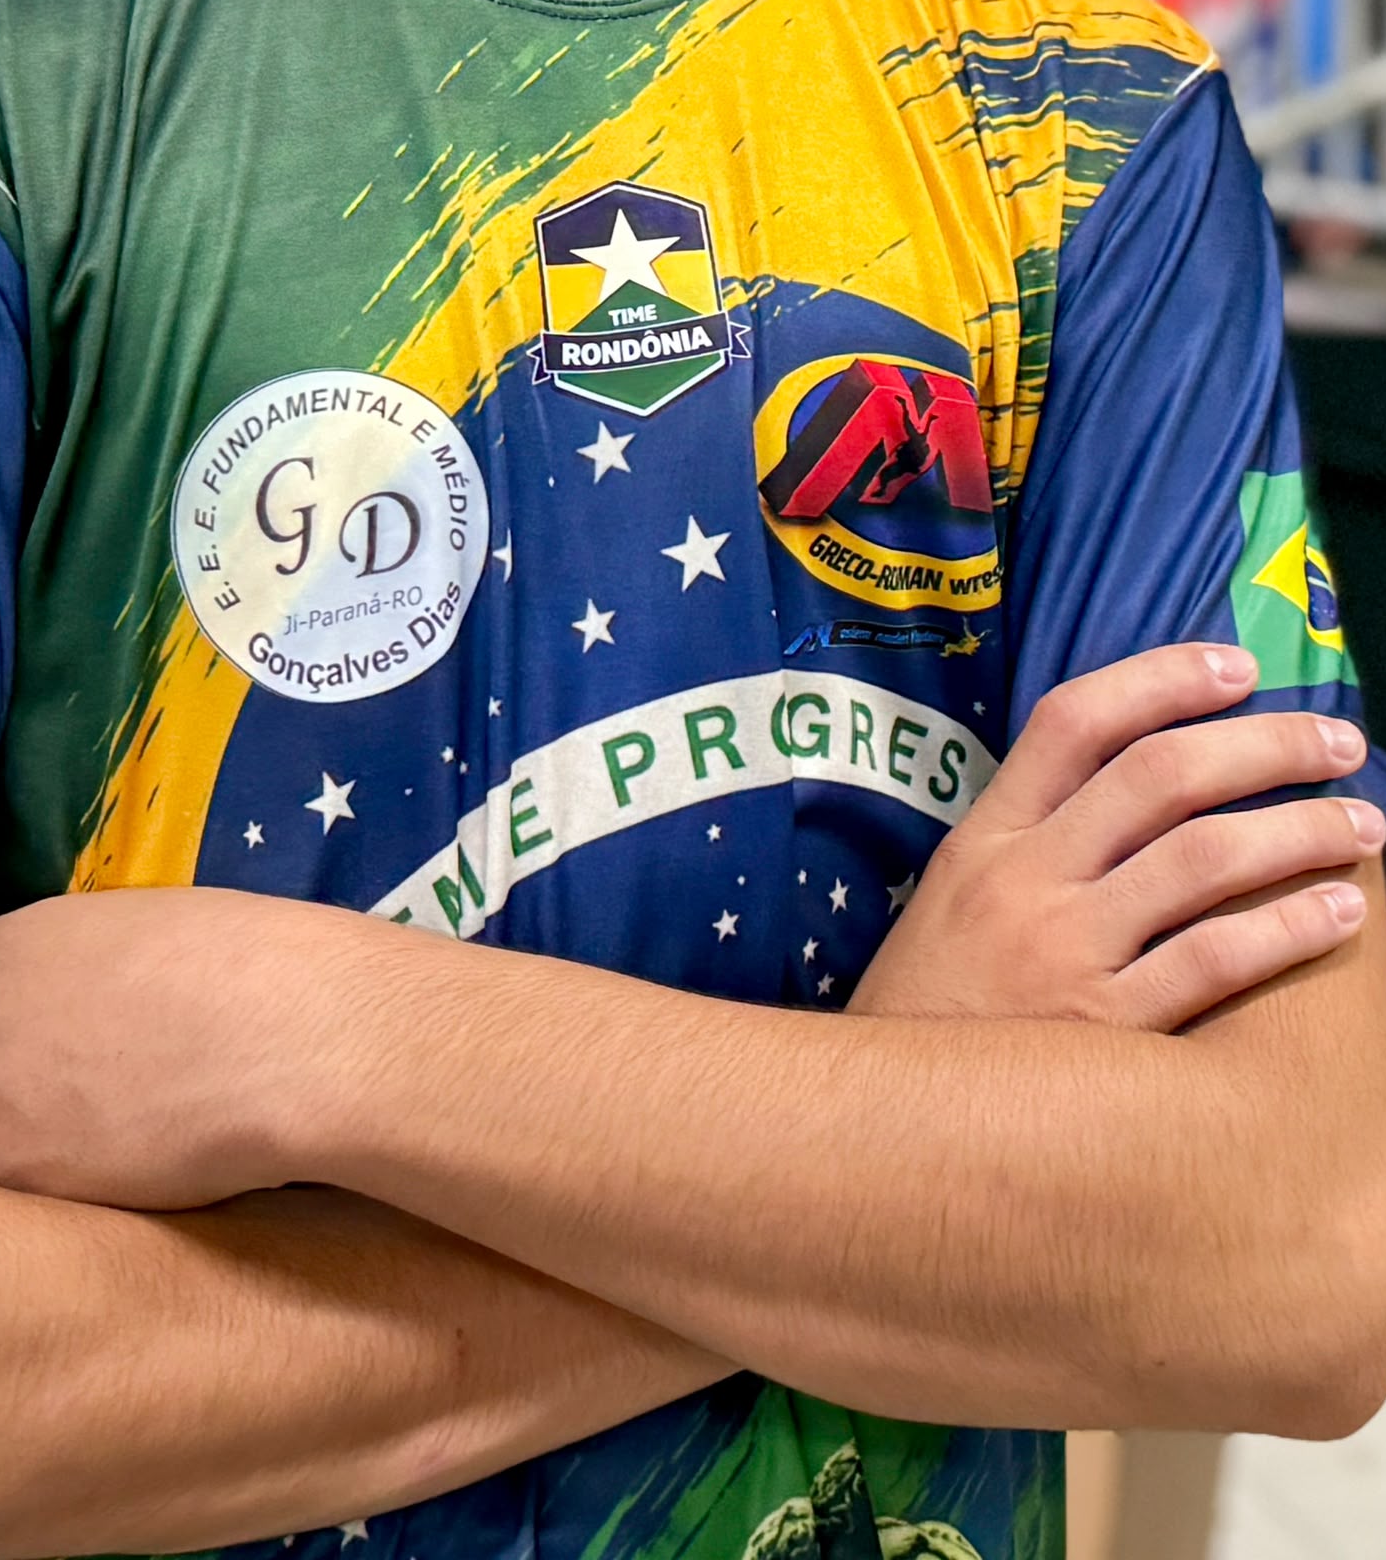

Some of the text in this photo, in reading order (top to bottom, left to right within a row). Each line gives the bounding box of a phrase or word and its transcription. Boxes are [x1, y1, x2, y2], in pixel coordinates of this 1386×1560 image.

[562, 325, 713, 367] RONDÔNIA
[608, 304, 658, 327] TIME
[194, 386, 469, 612] E. E. E. FUNDAMENTAL E MÉDIO
[247, 580, 463, 694] Gonçalves Dias
[282, 585, 424, 636] Ji-Paraná-RO
[510, 777, 553, 859] E
